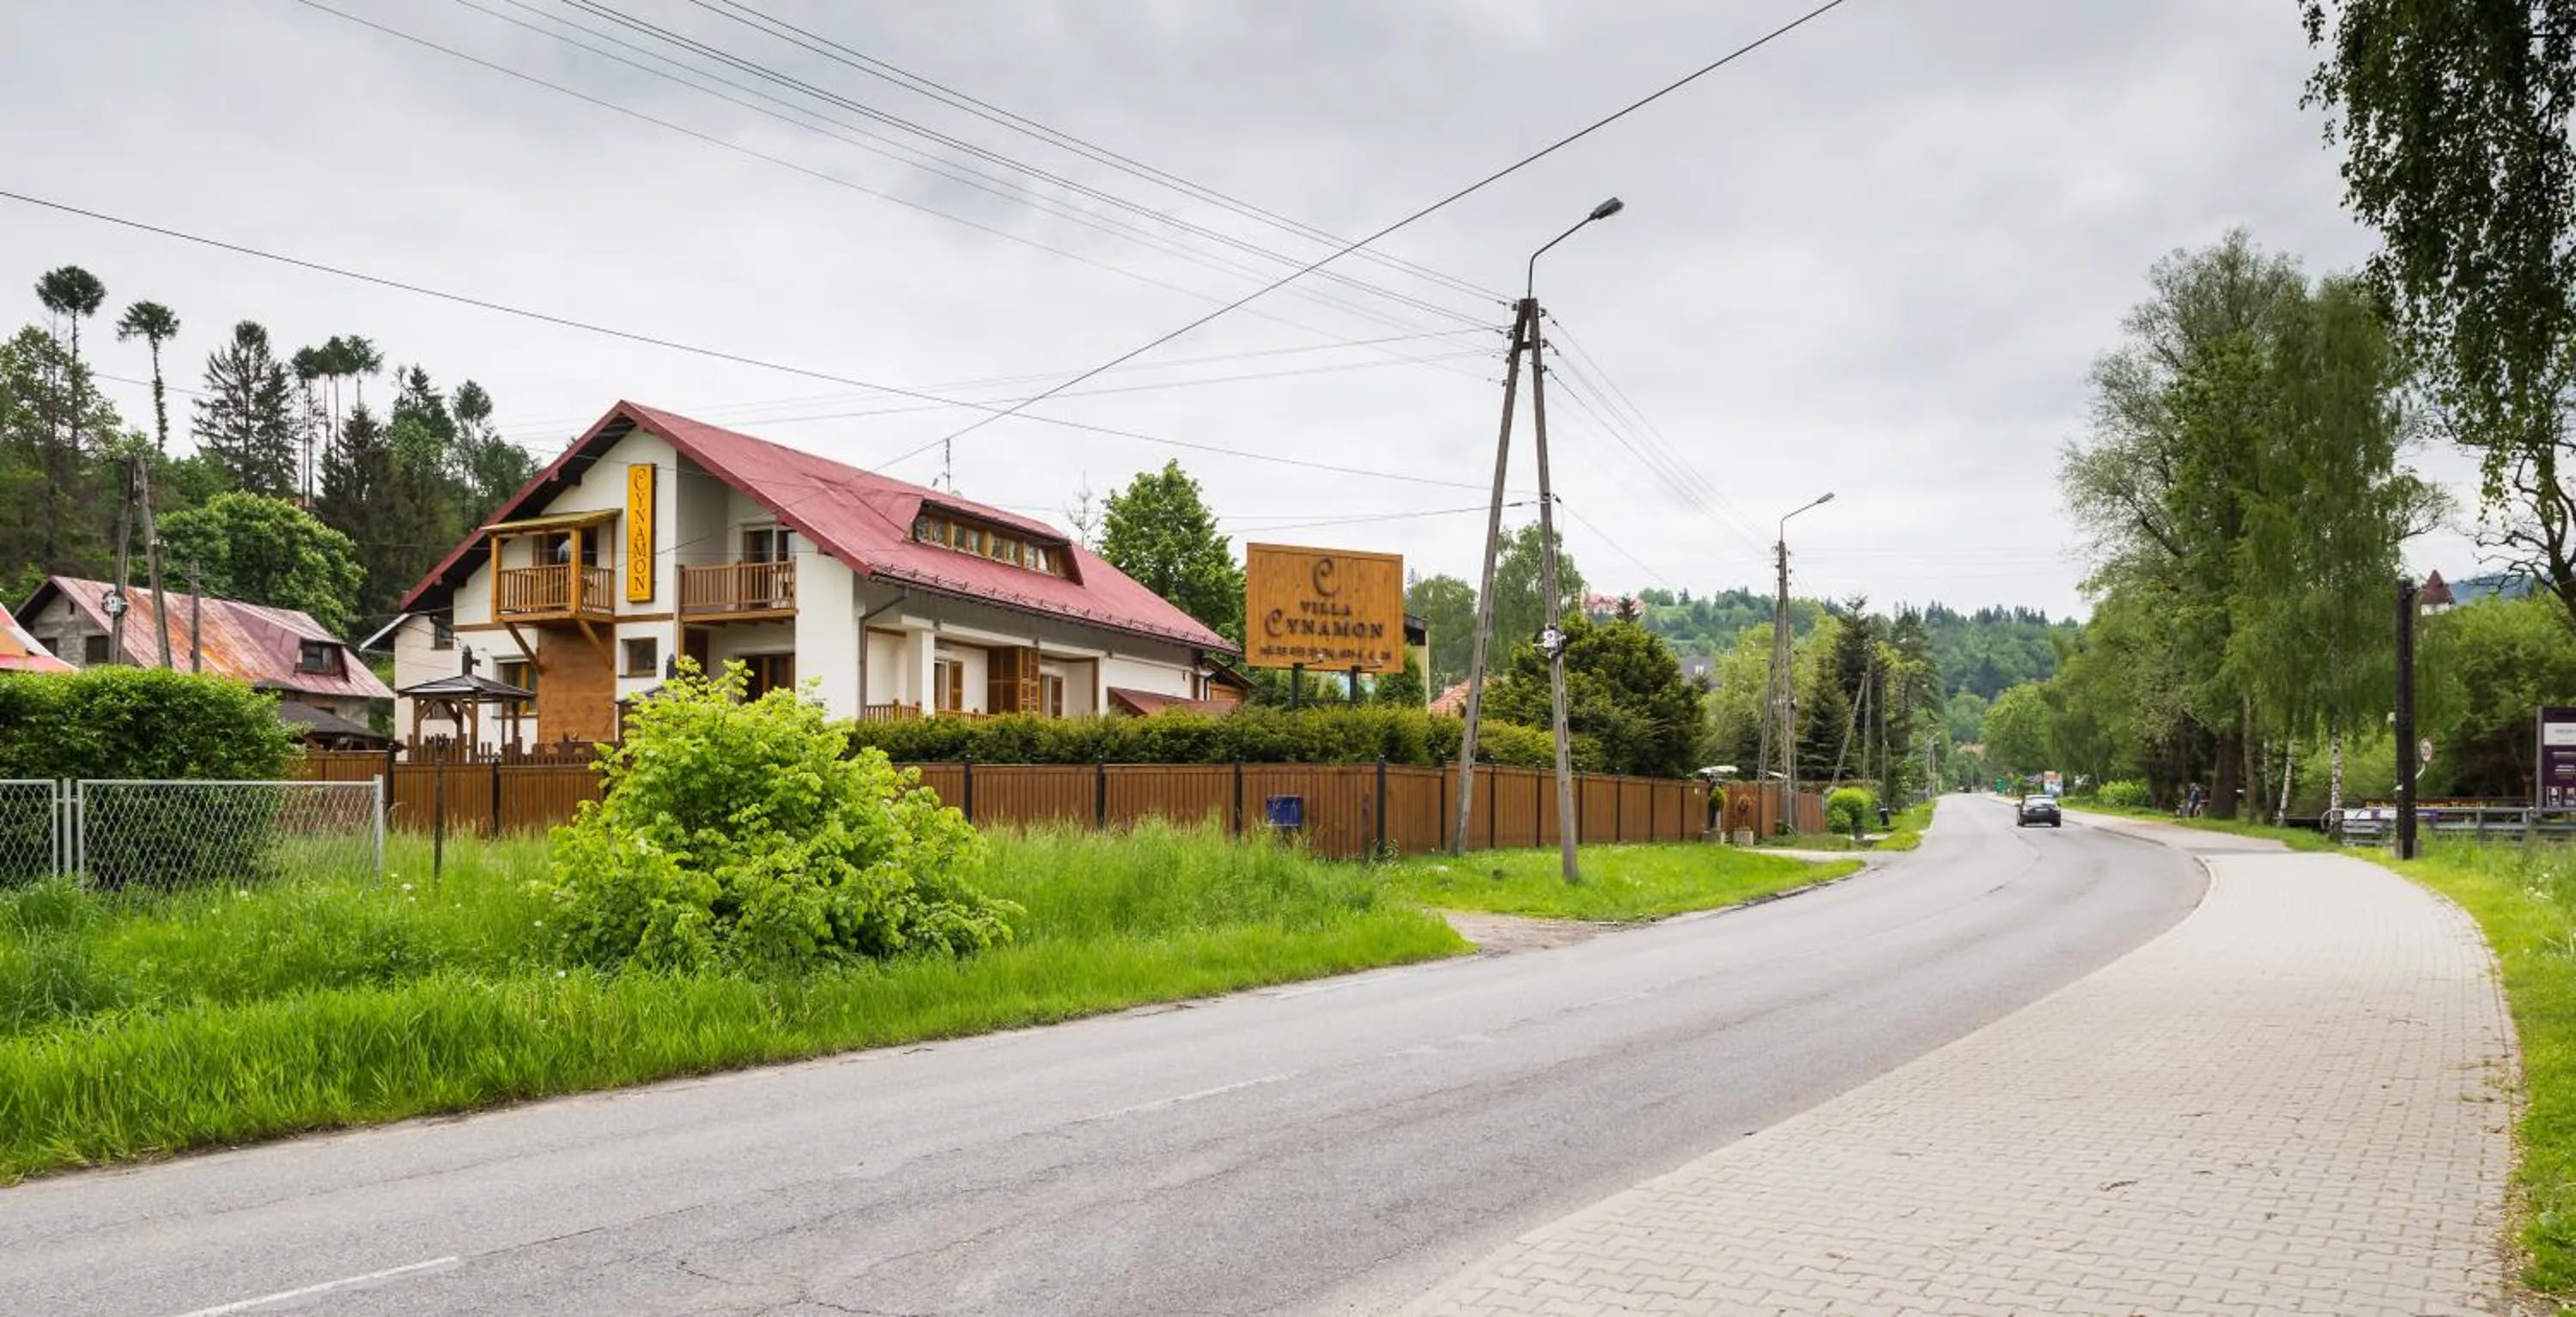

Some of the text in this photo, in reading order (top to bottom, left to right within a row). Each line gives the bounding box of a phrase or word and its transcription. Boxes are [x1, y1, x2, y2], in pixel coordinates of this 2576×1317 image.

[634, 469, 647, 592] CYNAMON
[1264, 608, 1383, 638] CYNAMON
[1300, 602, 1352, 616] VILLA
